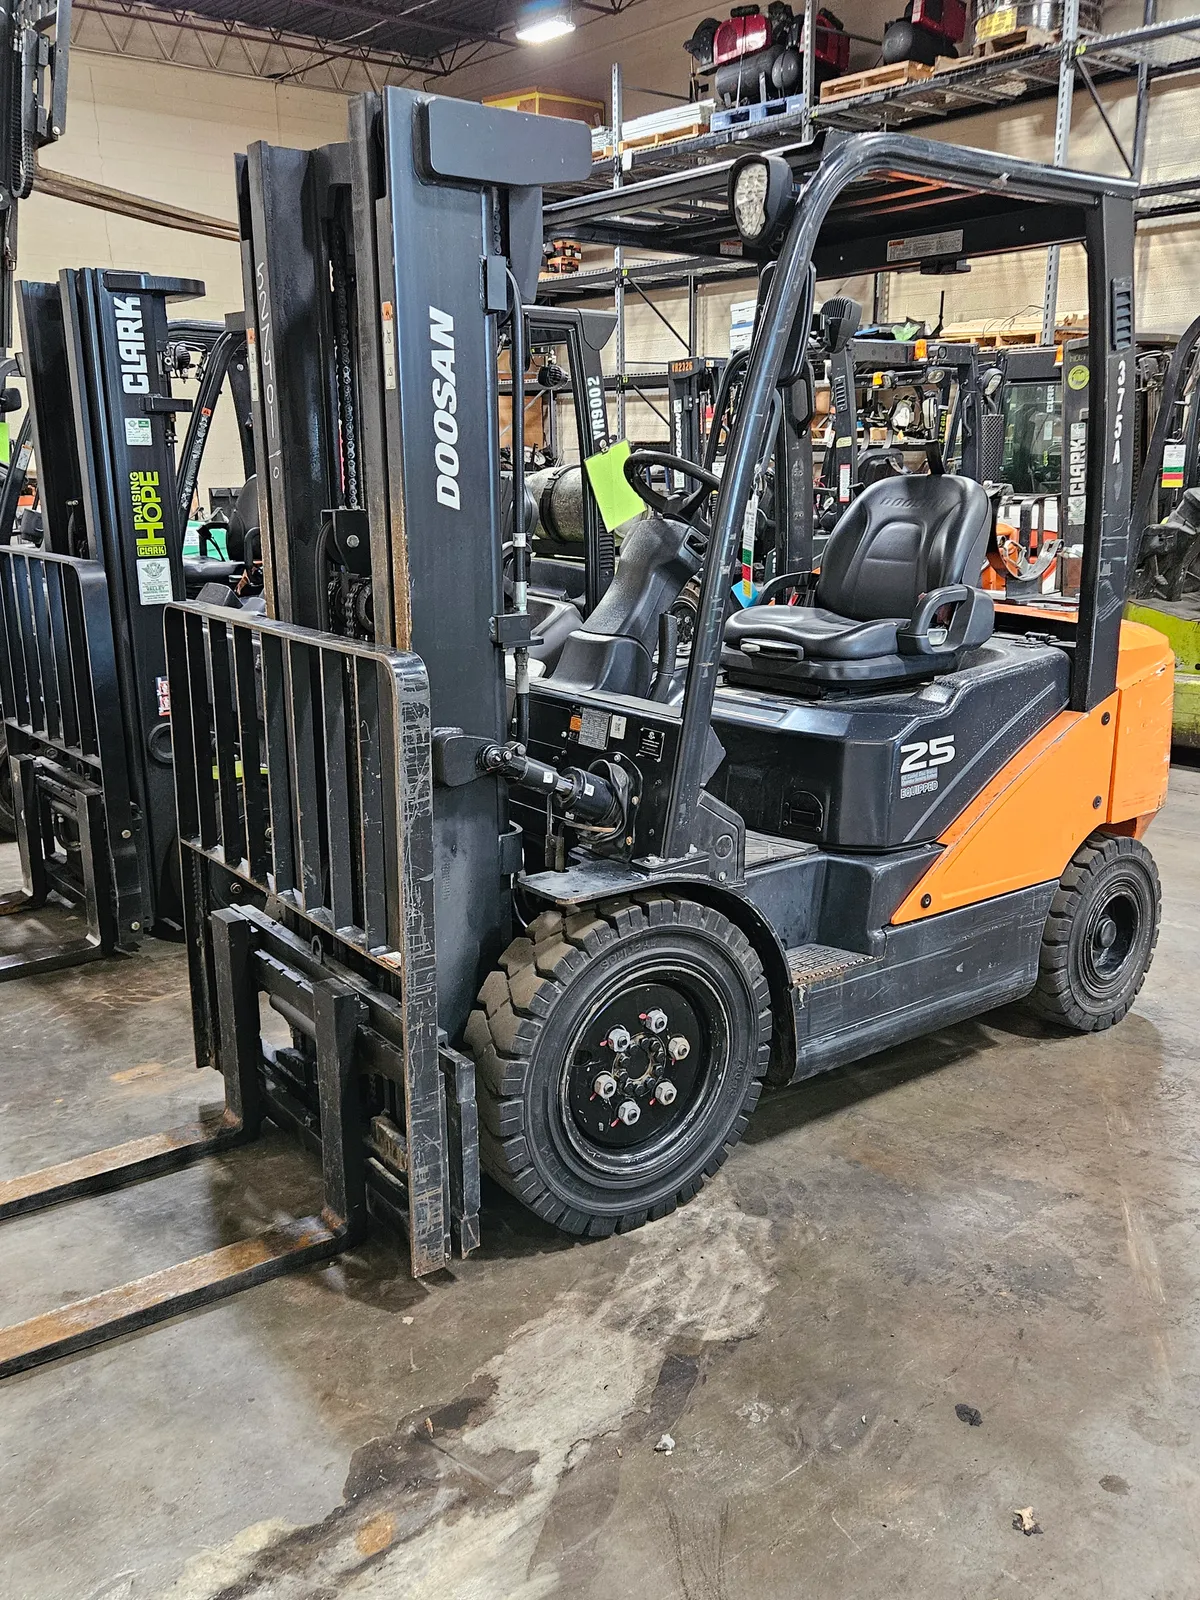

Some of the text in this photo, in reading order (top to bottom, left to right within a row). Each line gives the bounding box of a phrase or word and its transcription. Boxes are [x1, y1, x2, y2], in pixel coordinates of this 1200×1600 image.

[113, 296, 150, 394] CLARK
[429, 306, 461, 510] DOOSAN
[587, 375, 606, 440] VR9002
[1112, 360, 1126, 464] 375A
[129, 471, 144, 523] RAISING
[1069, 438, 1086, 495] CLARK
[134, 471, 165, 546] HOPE
[139, 545, 165, 556] CLARK
[900, 734, 955, 773] 25
[900, 780, 939, 799] EQUIPPED
